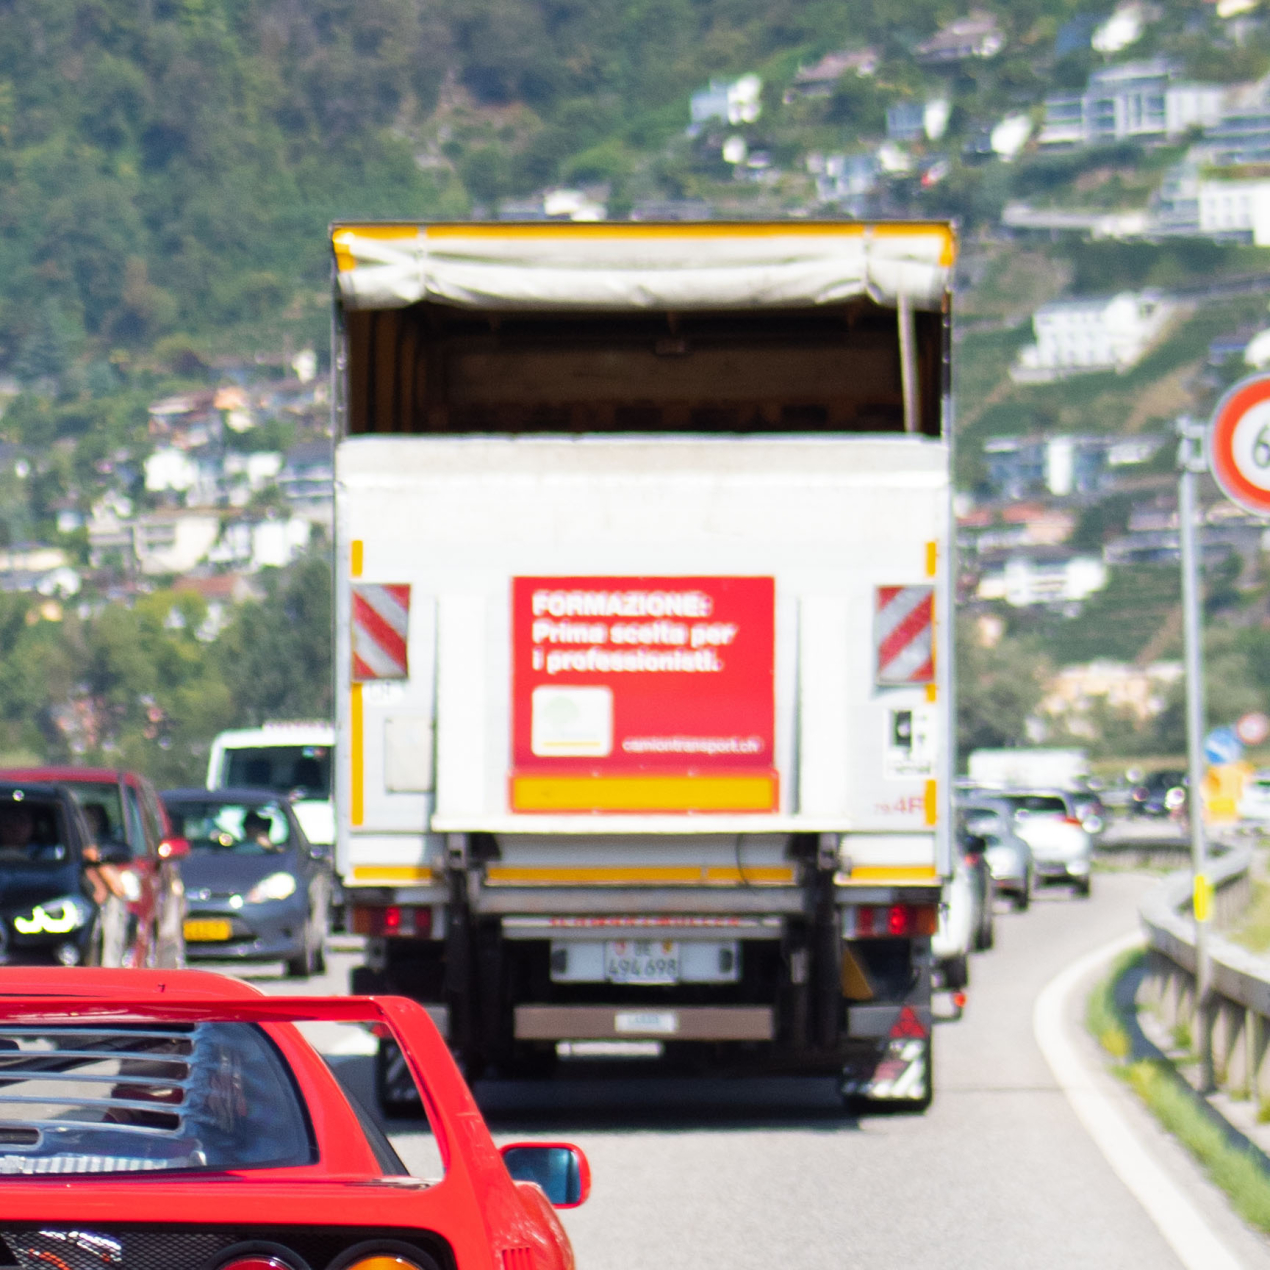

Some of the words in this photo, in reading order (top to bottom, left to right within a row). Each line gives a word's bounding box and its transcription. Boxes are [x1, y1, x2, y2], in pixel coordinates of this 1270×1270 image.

[1252, 423, 1270, 469] 6
[532, 590, 713, 617] FORMAZIONE:
[532, 618, 607, 644] Prima
[610, 620, 689, 645] scelta
[690, 623, 738, 649] per
[532, 646, 544, 670] i
[546, 646, 723, 675] professionisti.
